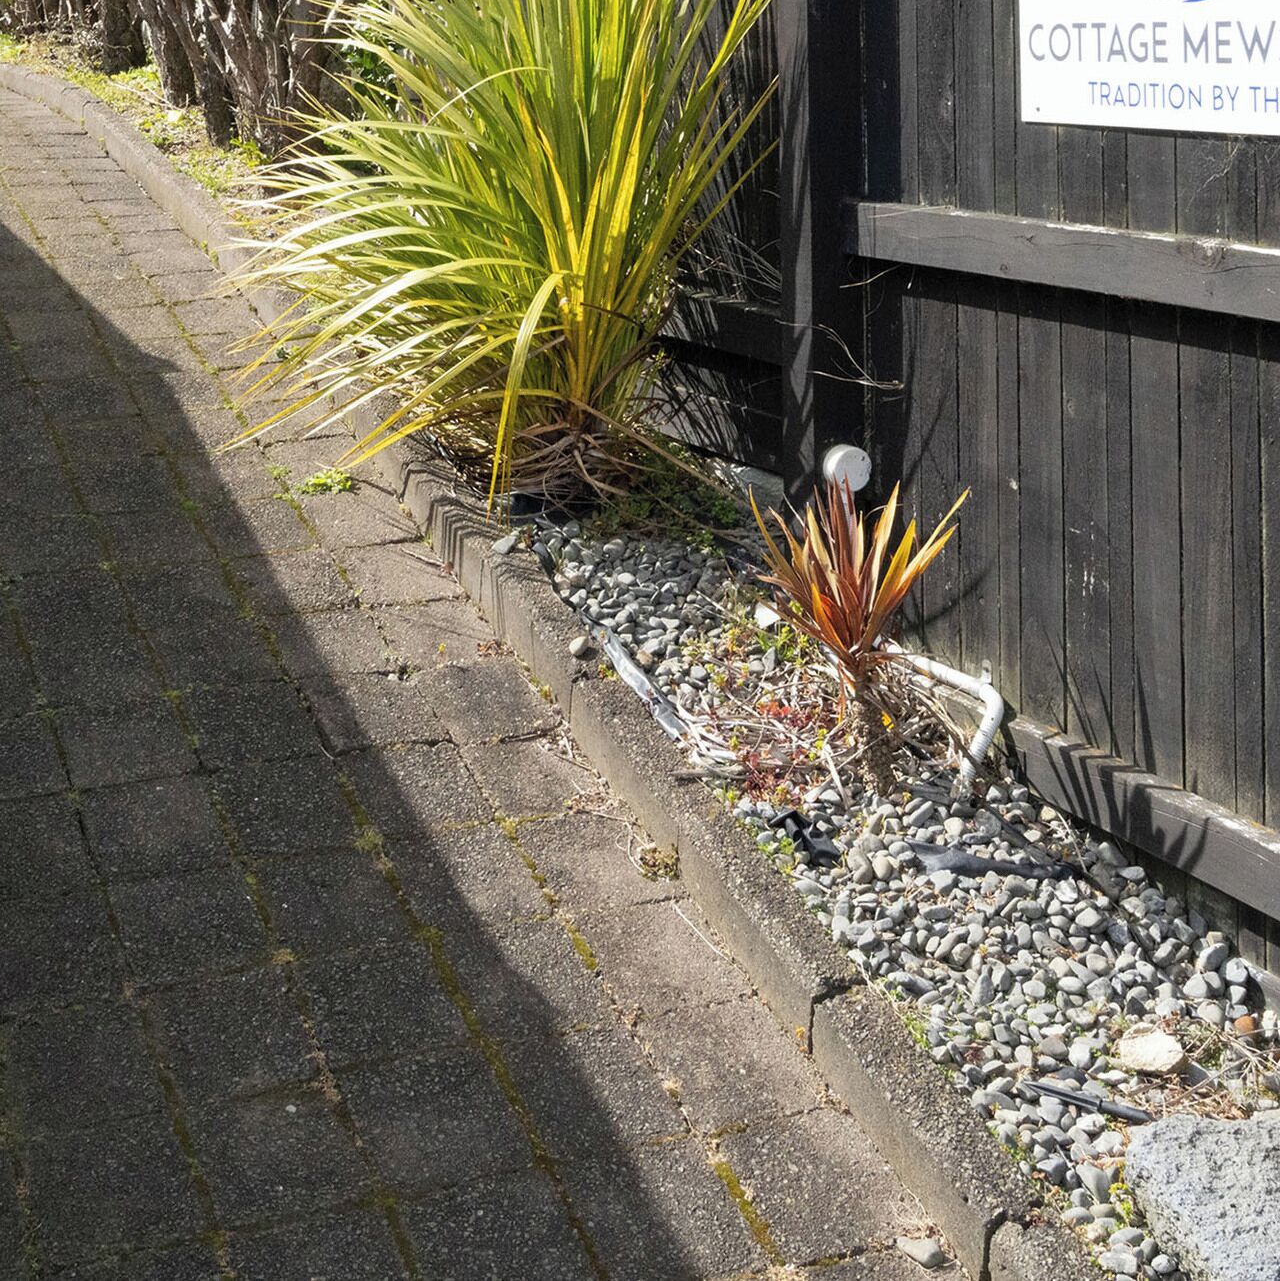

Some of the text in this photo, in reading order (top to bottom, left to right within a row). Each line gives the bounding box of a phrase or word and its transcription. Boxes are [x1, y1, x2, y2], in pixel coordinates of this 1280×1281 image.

[1029, 22, 1168, 63] COTTAGE
[1088, 82, 1201, 109] TRADITION
[1213, 85, 1239, 111] BY
